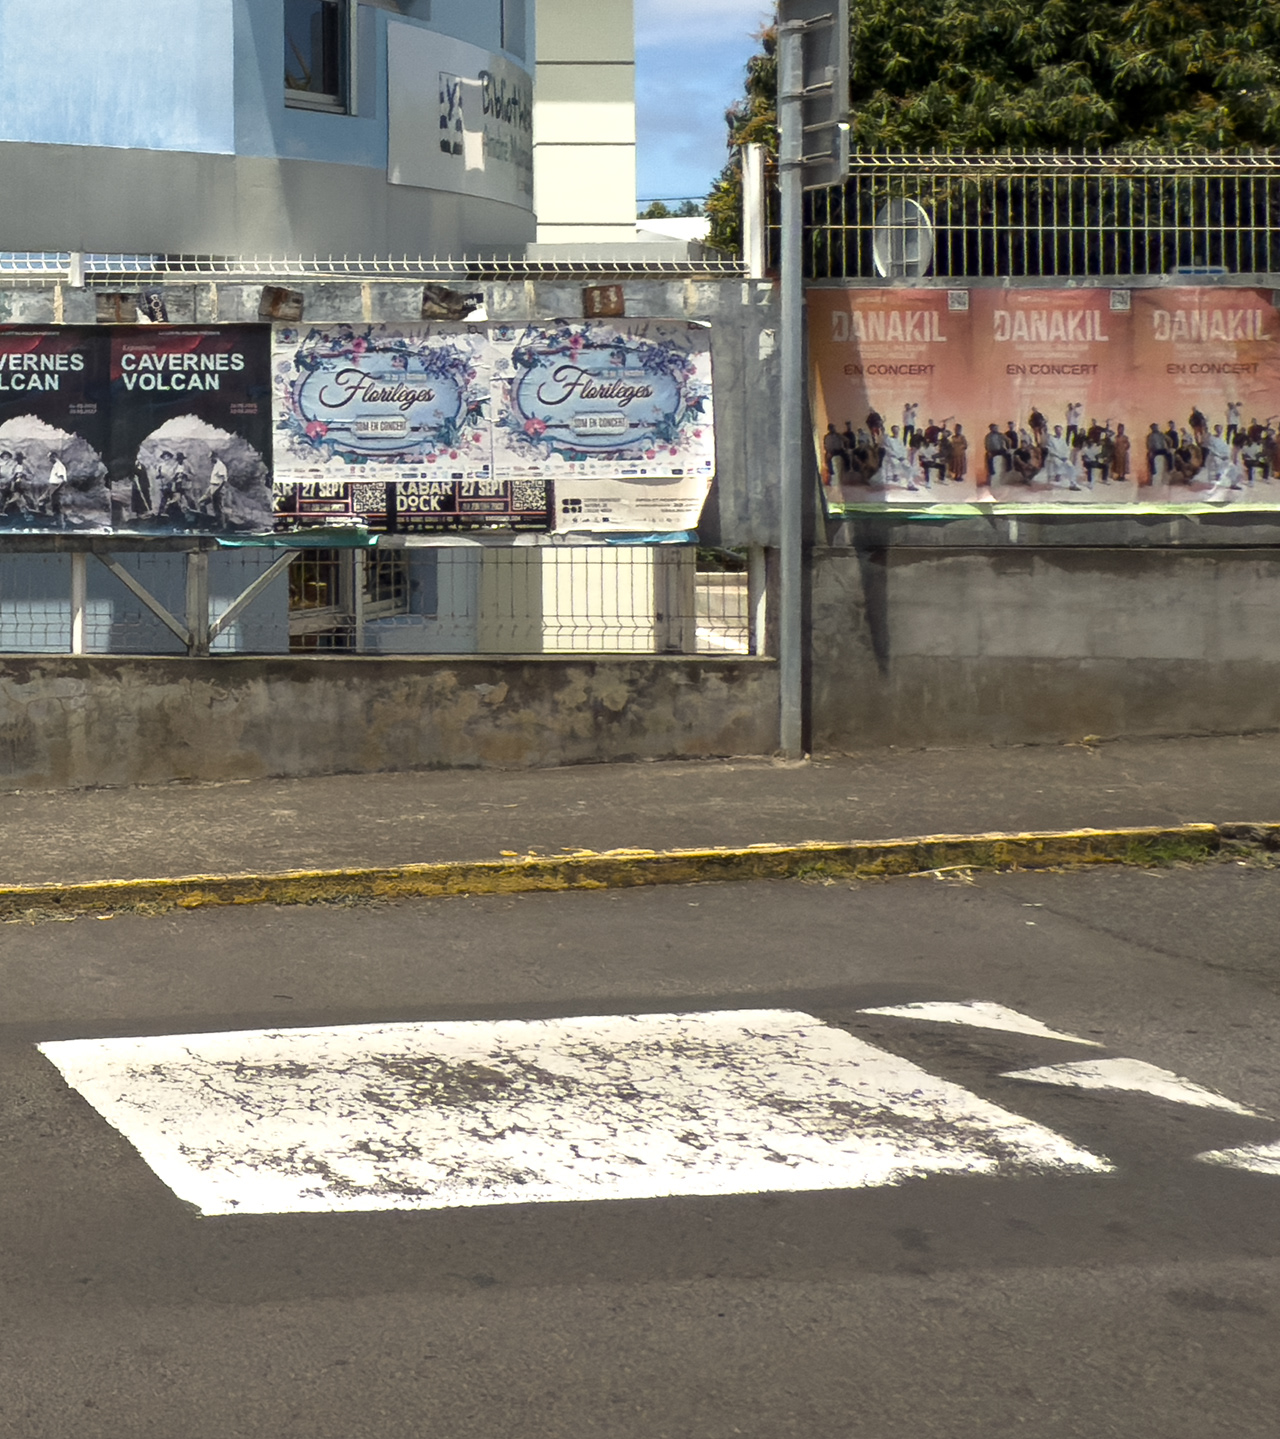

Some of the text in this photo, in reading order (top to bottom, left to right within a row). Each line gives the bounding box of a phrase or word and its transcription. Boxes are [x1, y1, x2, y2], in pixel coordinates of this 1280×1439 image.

[832, 310, 947, 342] DANAKIL
[994, 310, 1110, 342] DANAKIL
[1153, 309, 1272, 341] DANAKIL
[121, 353, 245, 371] CAVERNES
[844, 364, 935, 375] EN CONCERT
[1006, 364, 1098, 375] EN CONCERT
[1167, 363, 1259, 374] EN CONCERT
[122, 373, 220, 390] VOLCAN
[319, 368, 435, 411] Florilèges
[380, 421, 406, 431] CONCERT
[599, 417, 625, 427] CONCERT
[302, 482, 345, 497] 27 SEPT
[396, 481, 452, 495] KABAR
[461, 481, 505, 496] 27 SEPT
